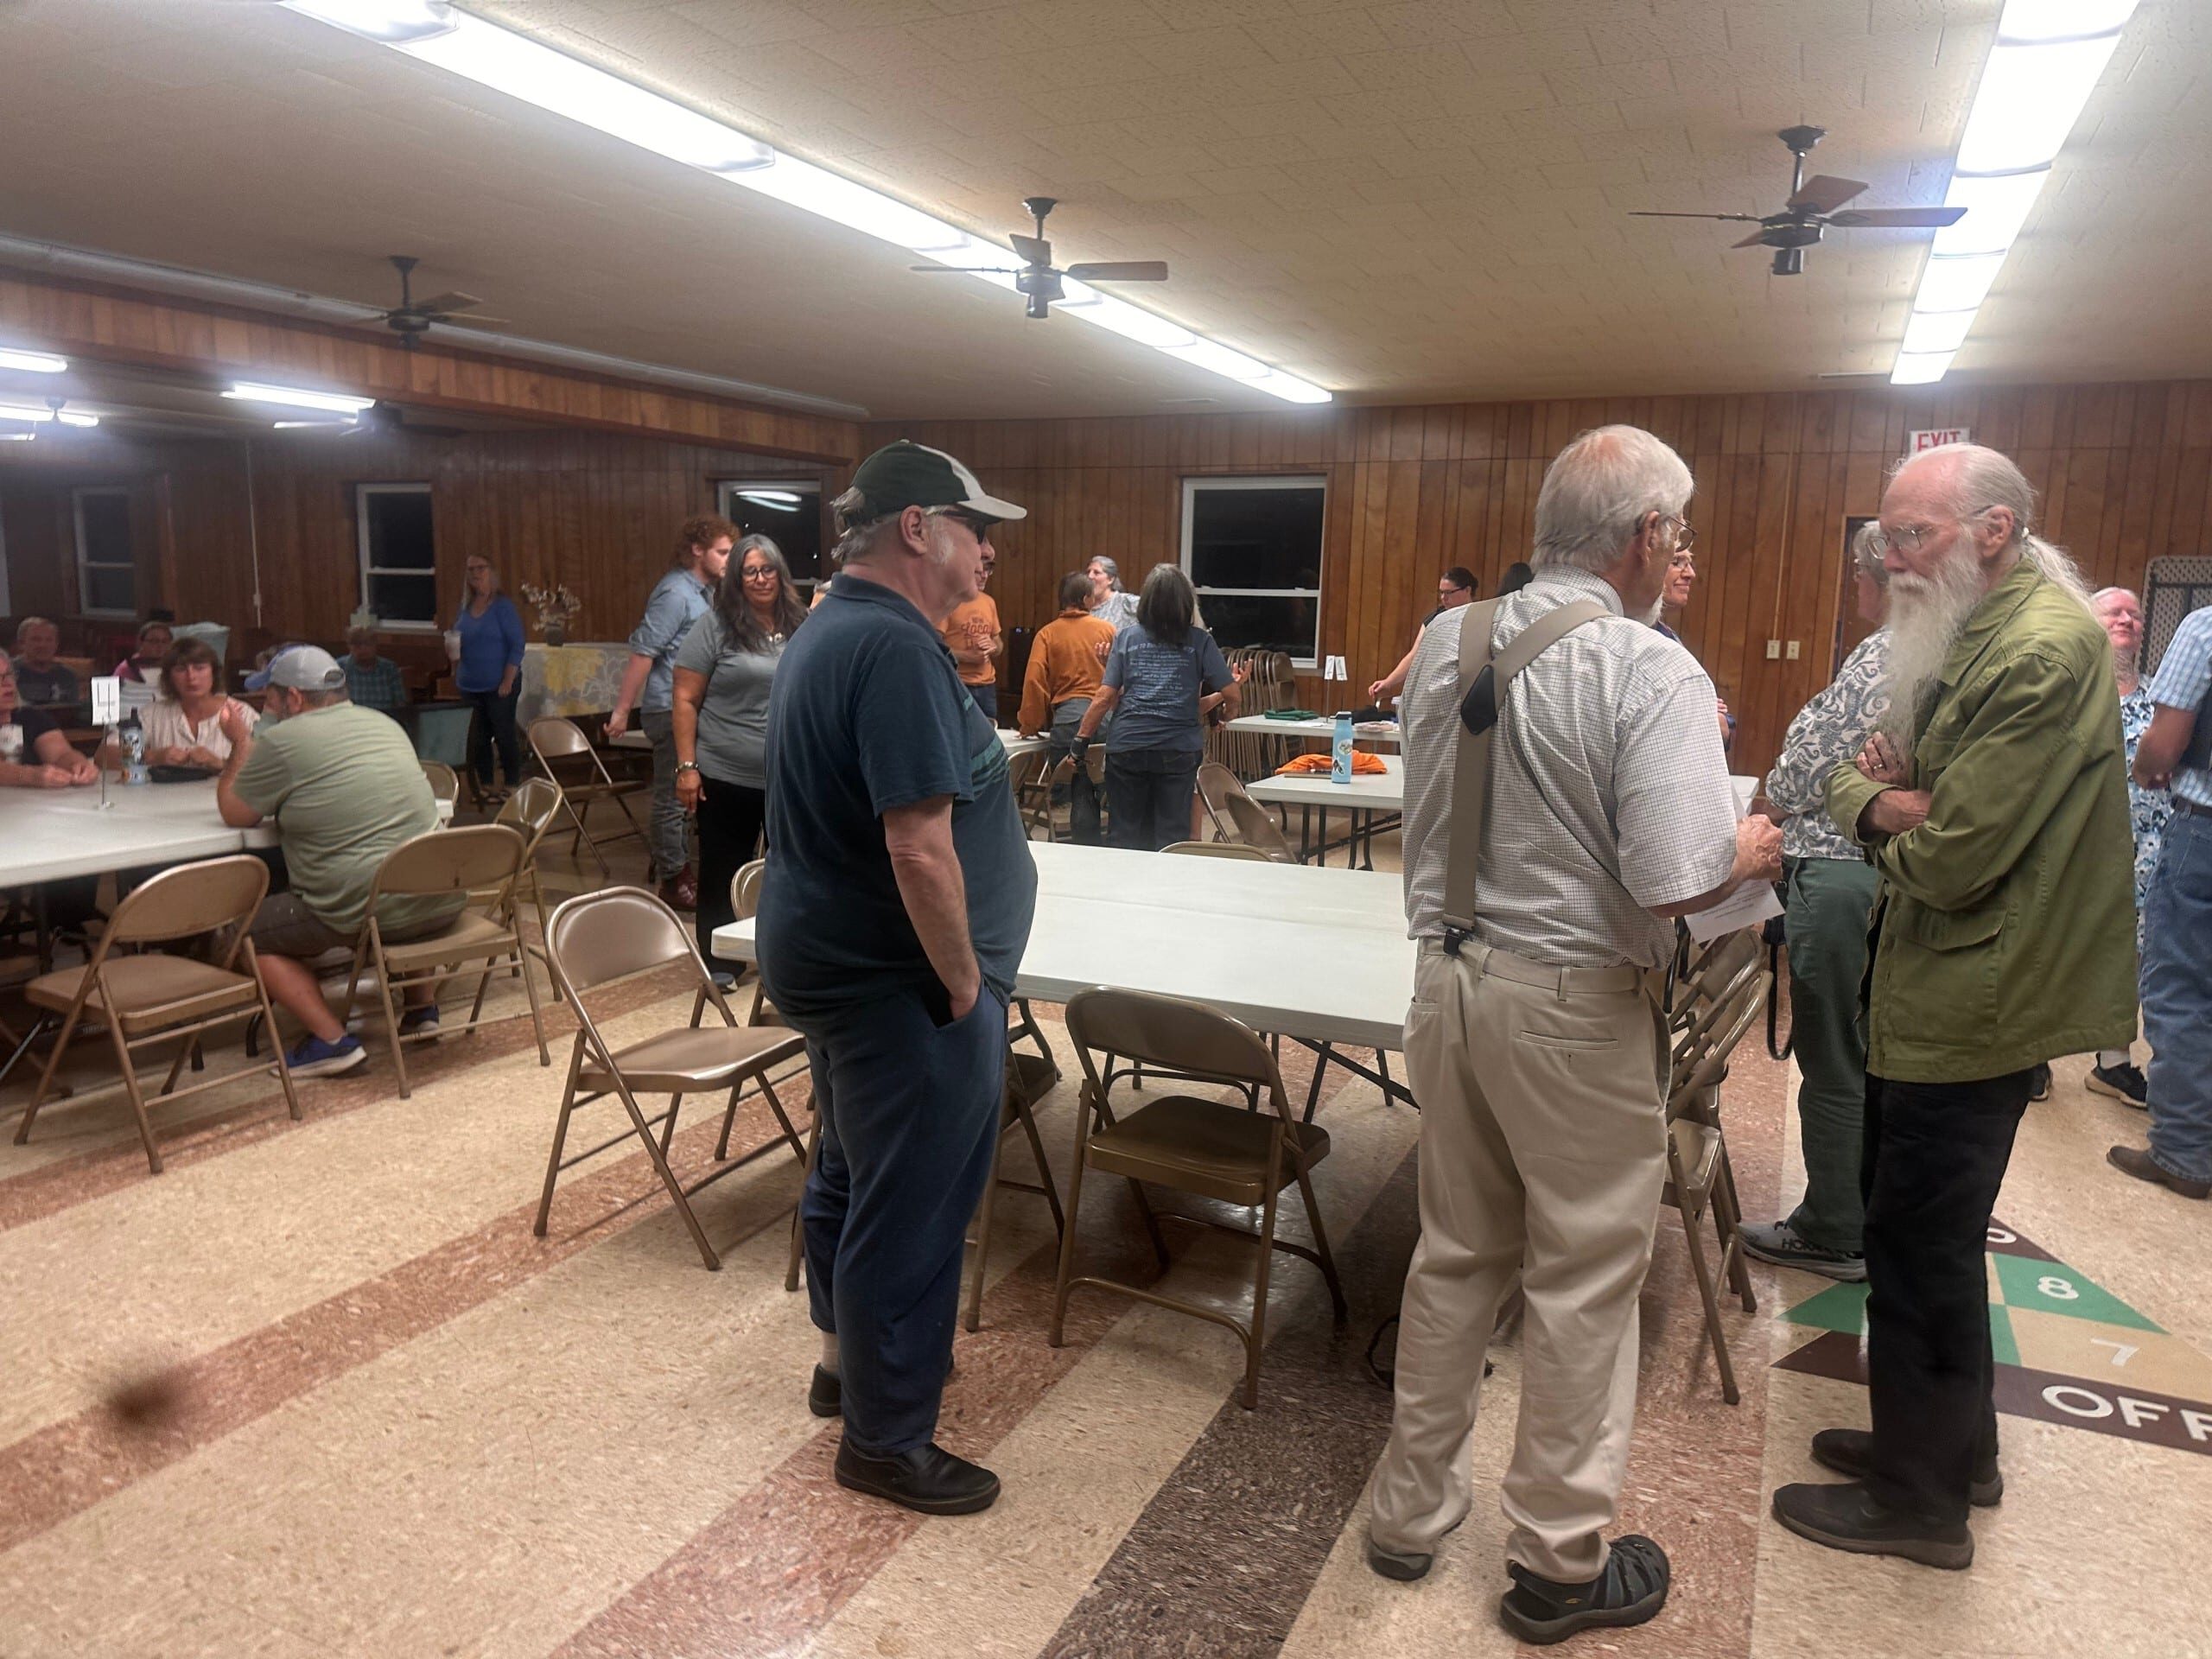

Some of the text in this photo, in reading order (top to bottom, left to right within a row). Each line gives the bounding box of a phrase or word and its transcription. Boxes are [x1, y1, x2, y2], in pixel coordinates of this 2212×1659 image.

[2037, 1276, 2079, 1300] 8
[2090, 1338, 2140, 1368] 7
[2042, 1385, 2212, 1441] OFF
